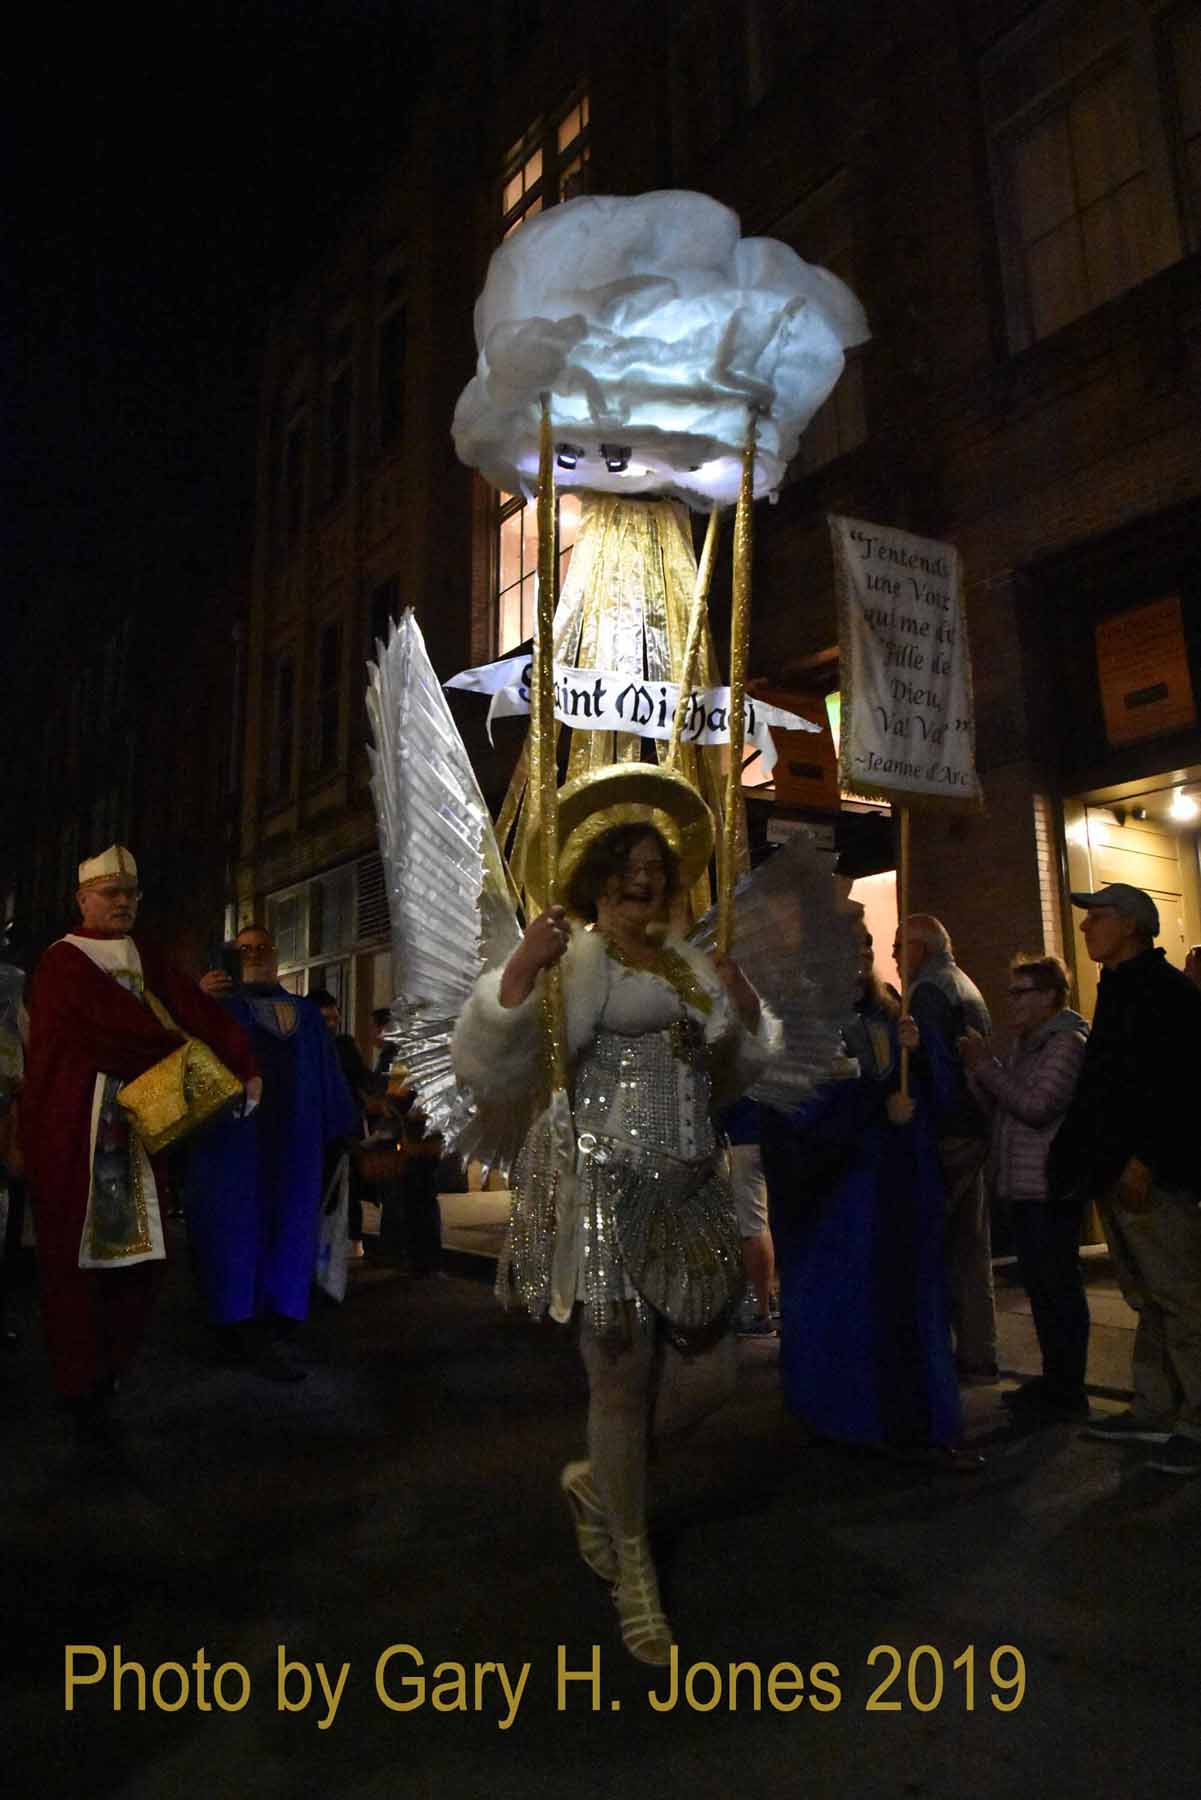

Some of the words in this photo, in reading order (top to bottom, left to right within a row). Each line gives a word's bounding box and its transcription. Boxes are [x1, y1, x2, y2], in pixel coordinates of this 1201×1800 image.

[900, 615, 930, 637] me
[518, 662, 607, 718] Sint
[615, 683, 756, 741] Mihal
